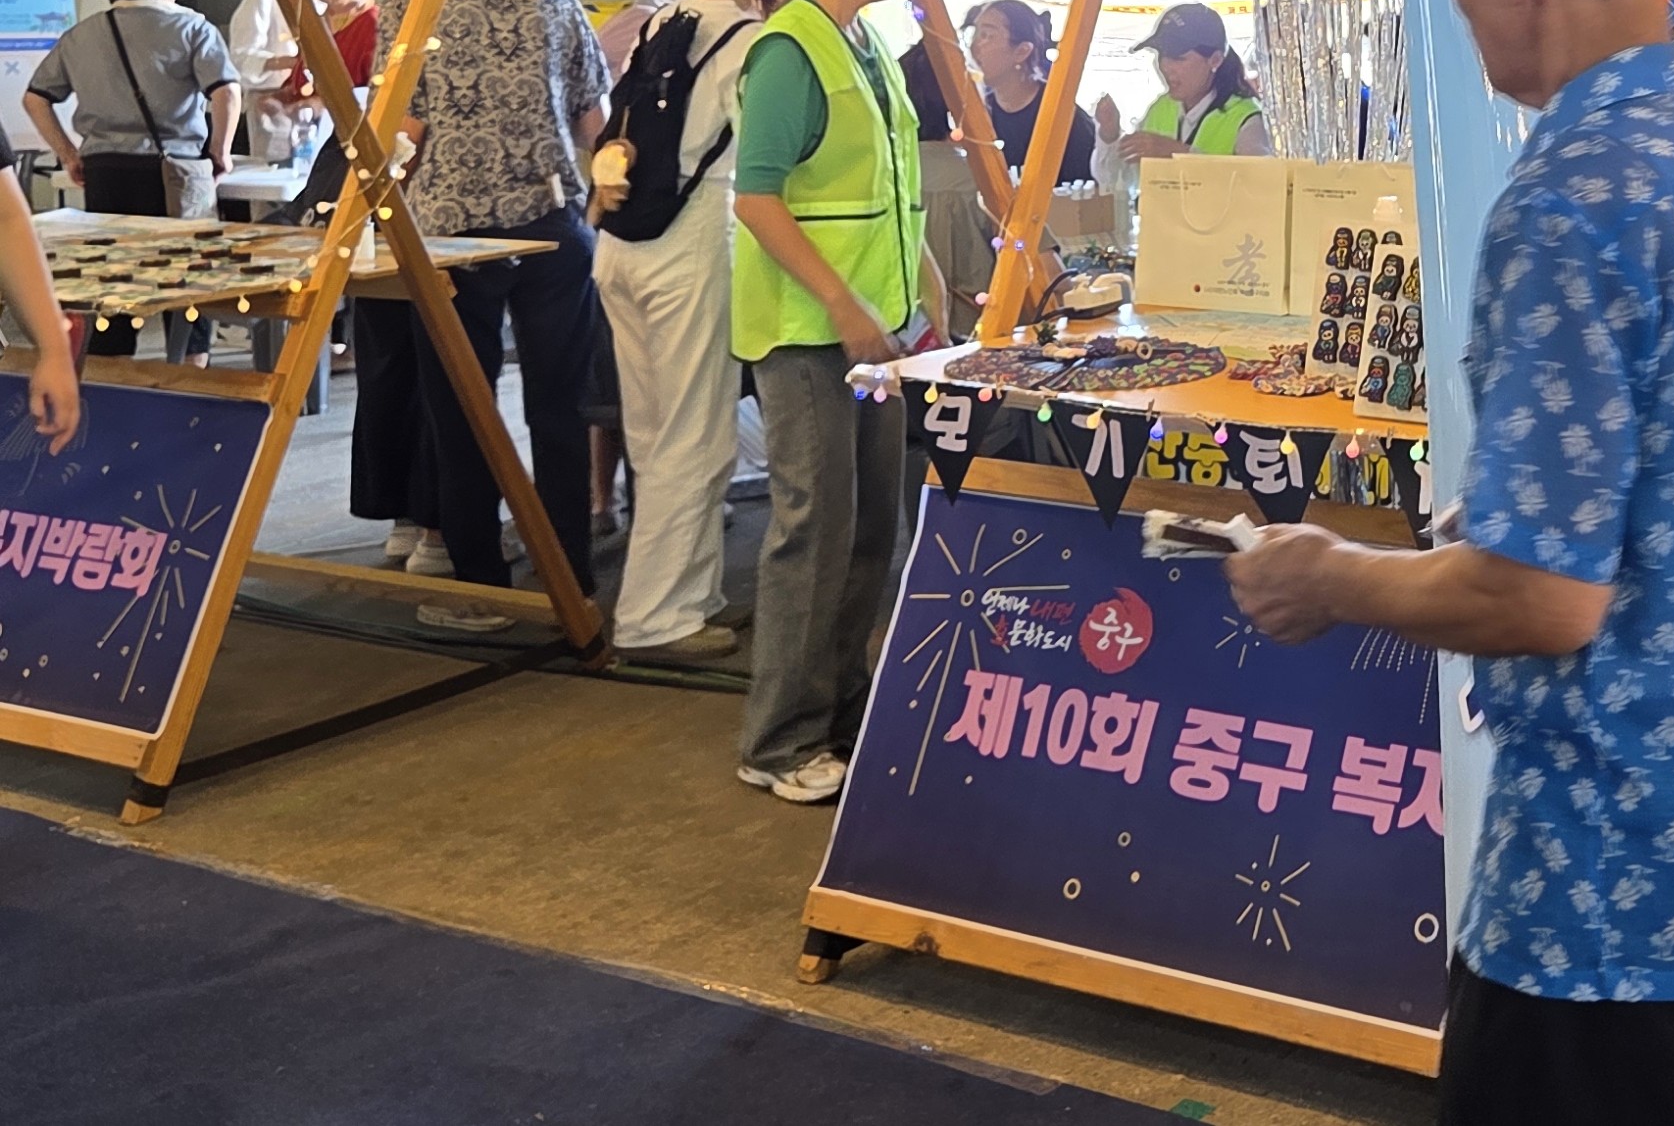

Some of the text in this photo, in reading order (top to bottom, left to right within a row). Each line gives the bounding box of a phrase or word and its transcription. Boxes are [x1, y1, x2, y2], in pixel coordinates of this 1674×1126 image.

[924, 393, 972, 452] 모
[1071, 414, 1125, 478] 기
[1239, 429, 1304, 494] 퇴
[0, 509, 168, 597] 지박람회
[1088, 606, 1144, 661] 중구
[943, 669, 1160, 784] 제10회
[1169, 707, 1314, 814] 중구
